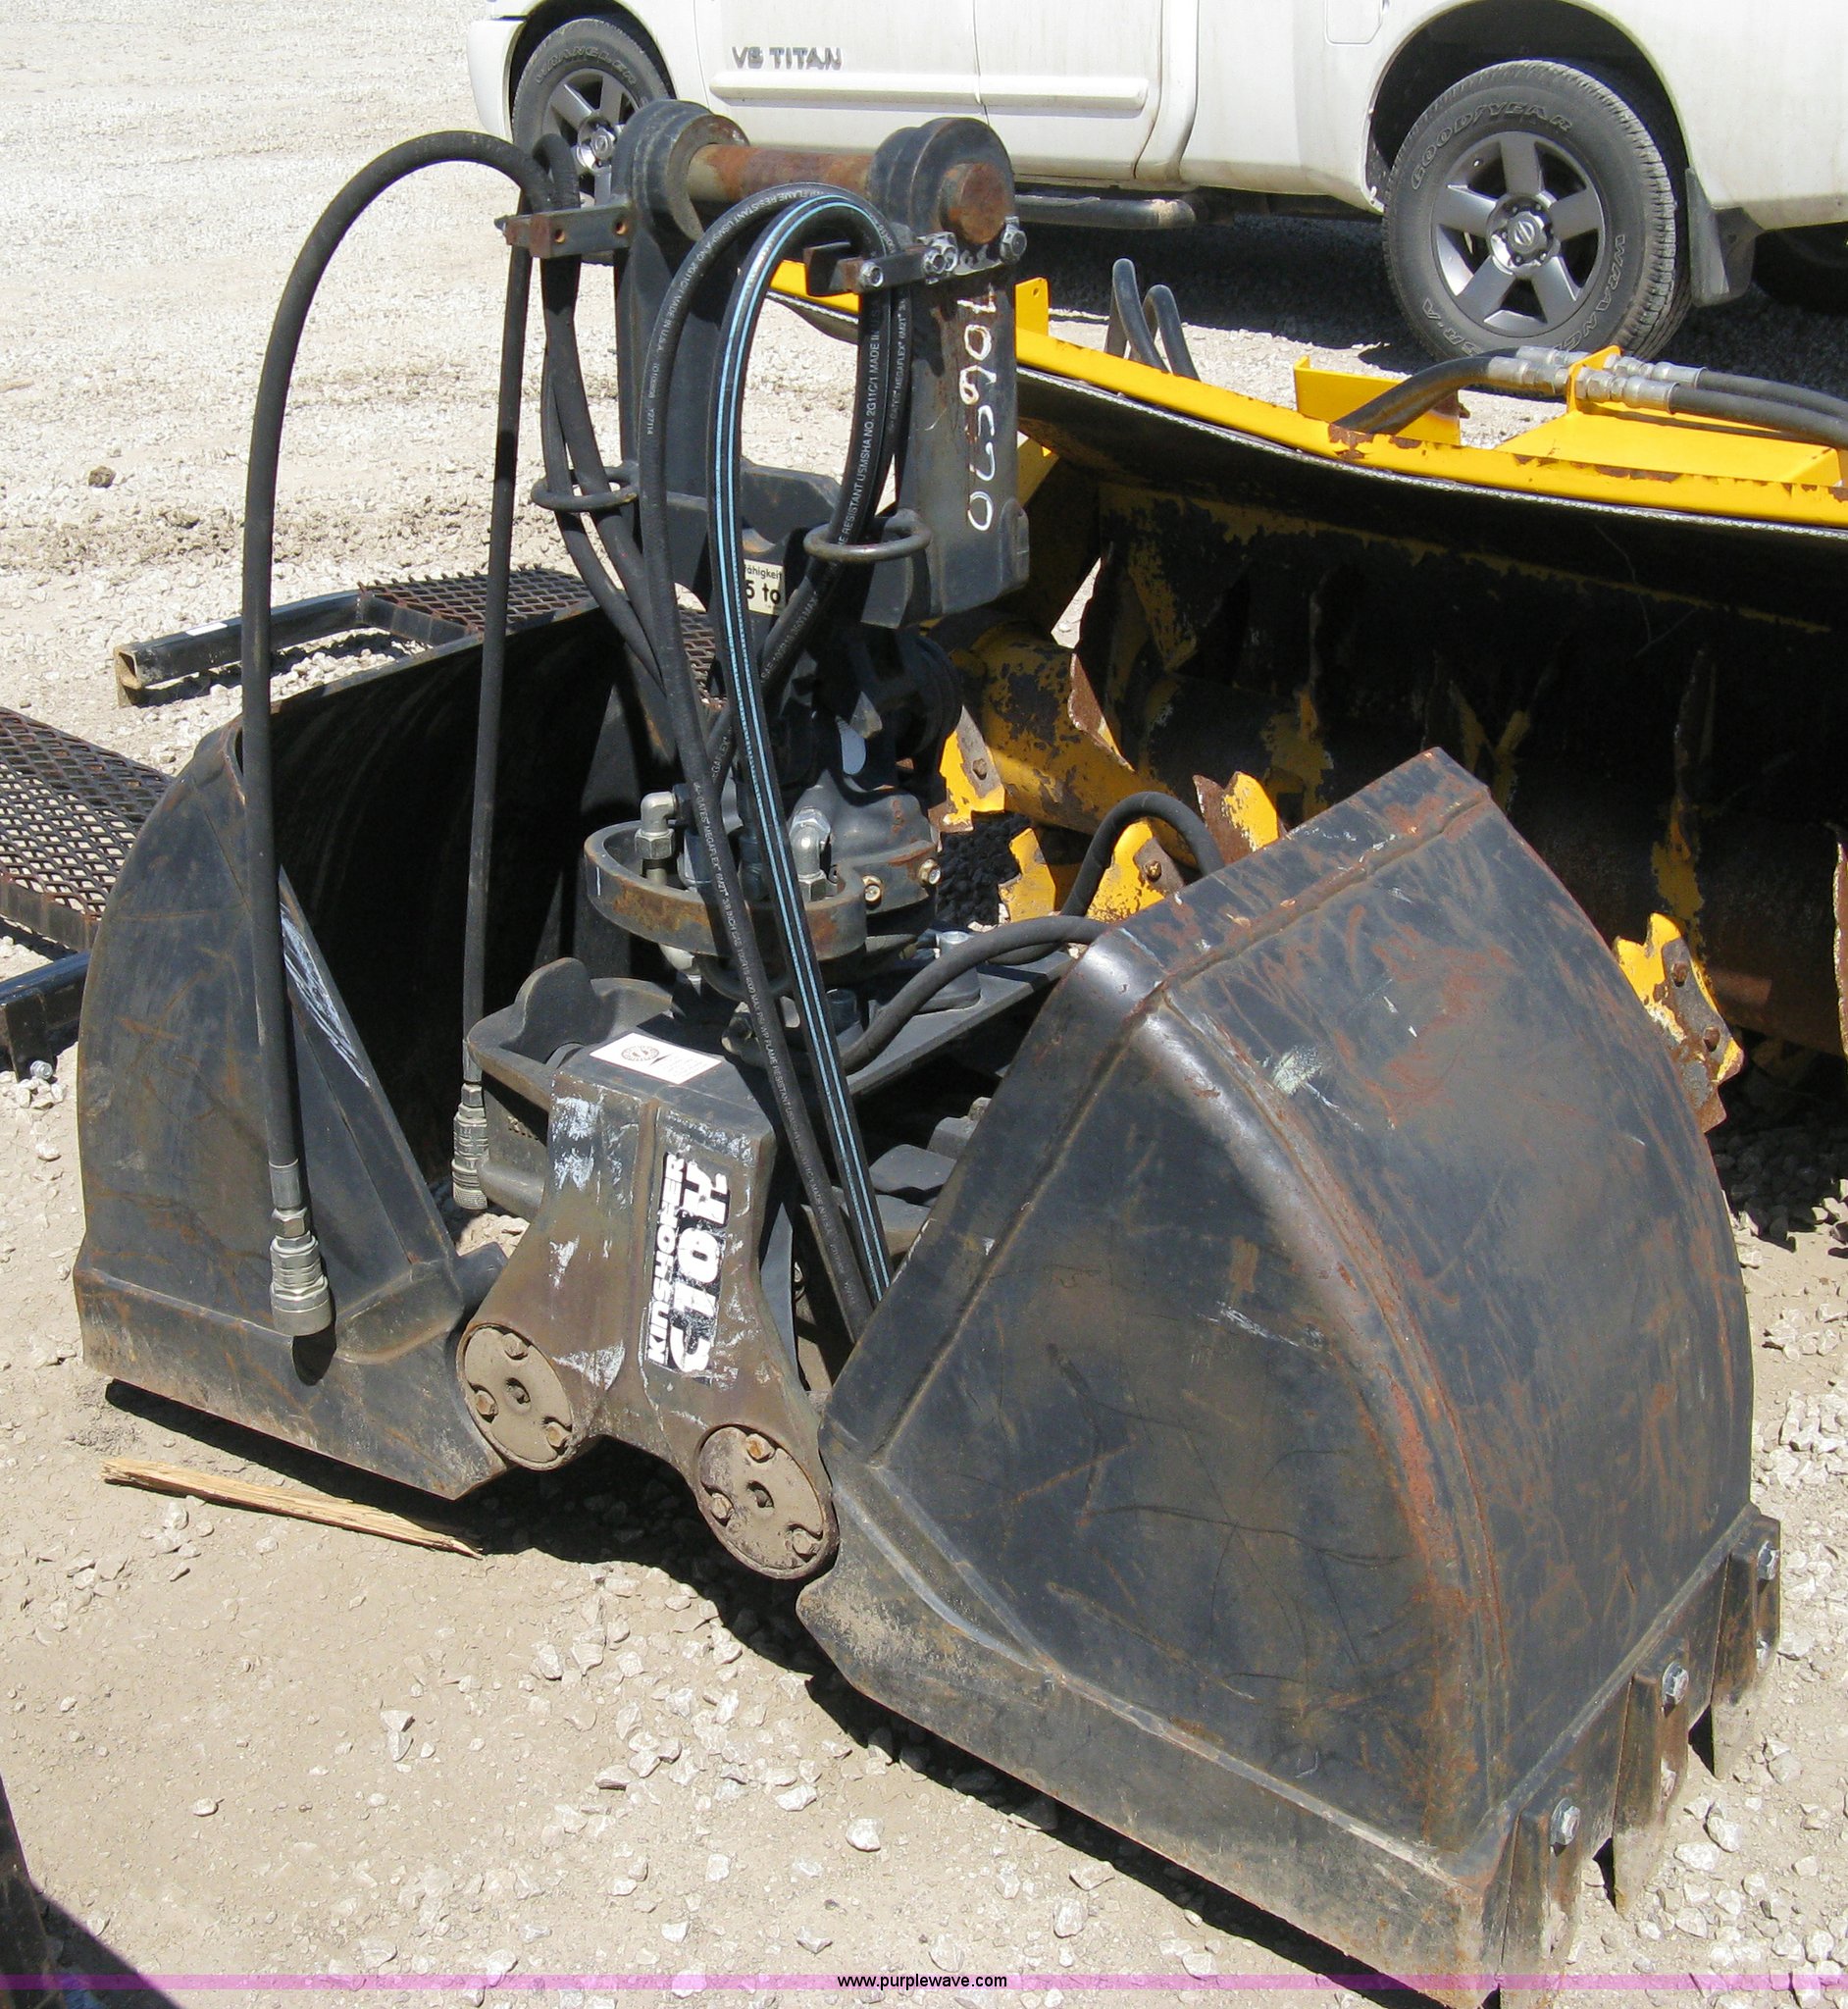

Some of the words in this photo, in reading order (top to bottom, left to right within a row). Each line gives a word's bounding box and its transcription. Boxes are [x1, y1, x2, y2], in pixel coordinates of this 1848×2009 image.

[536, 45, 637, 85] WRANGLER
[769, 46, 842, 71] TITAN
[1412, 102, 1572, 190] GOODYEAR
[840, 482, 863, 535] RESISTANT
[853, 436, 873, 481] USMSHA
[868, 342, 880, 373] MADE
[745, 564, 782, 580] ähigkeit
[762, 583, 781, 604] to
[700, 824, 722, 868] MEGAFLEX
[763, 1038, 777, 1064] FLAME
[771, 1064, 792, 1107] RESISTANT
[647, 1154, 685, 1365] KINSHOFER
